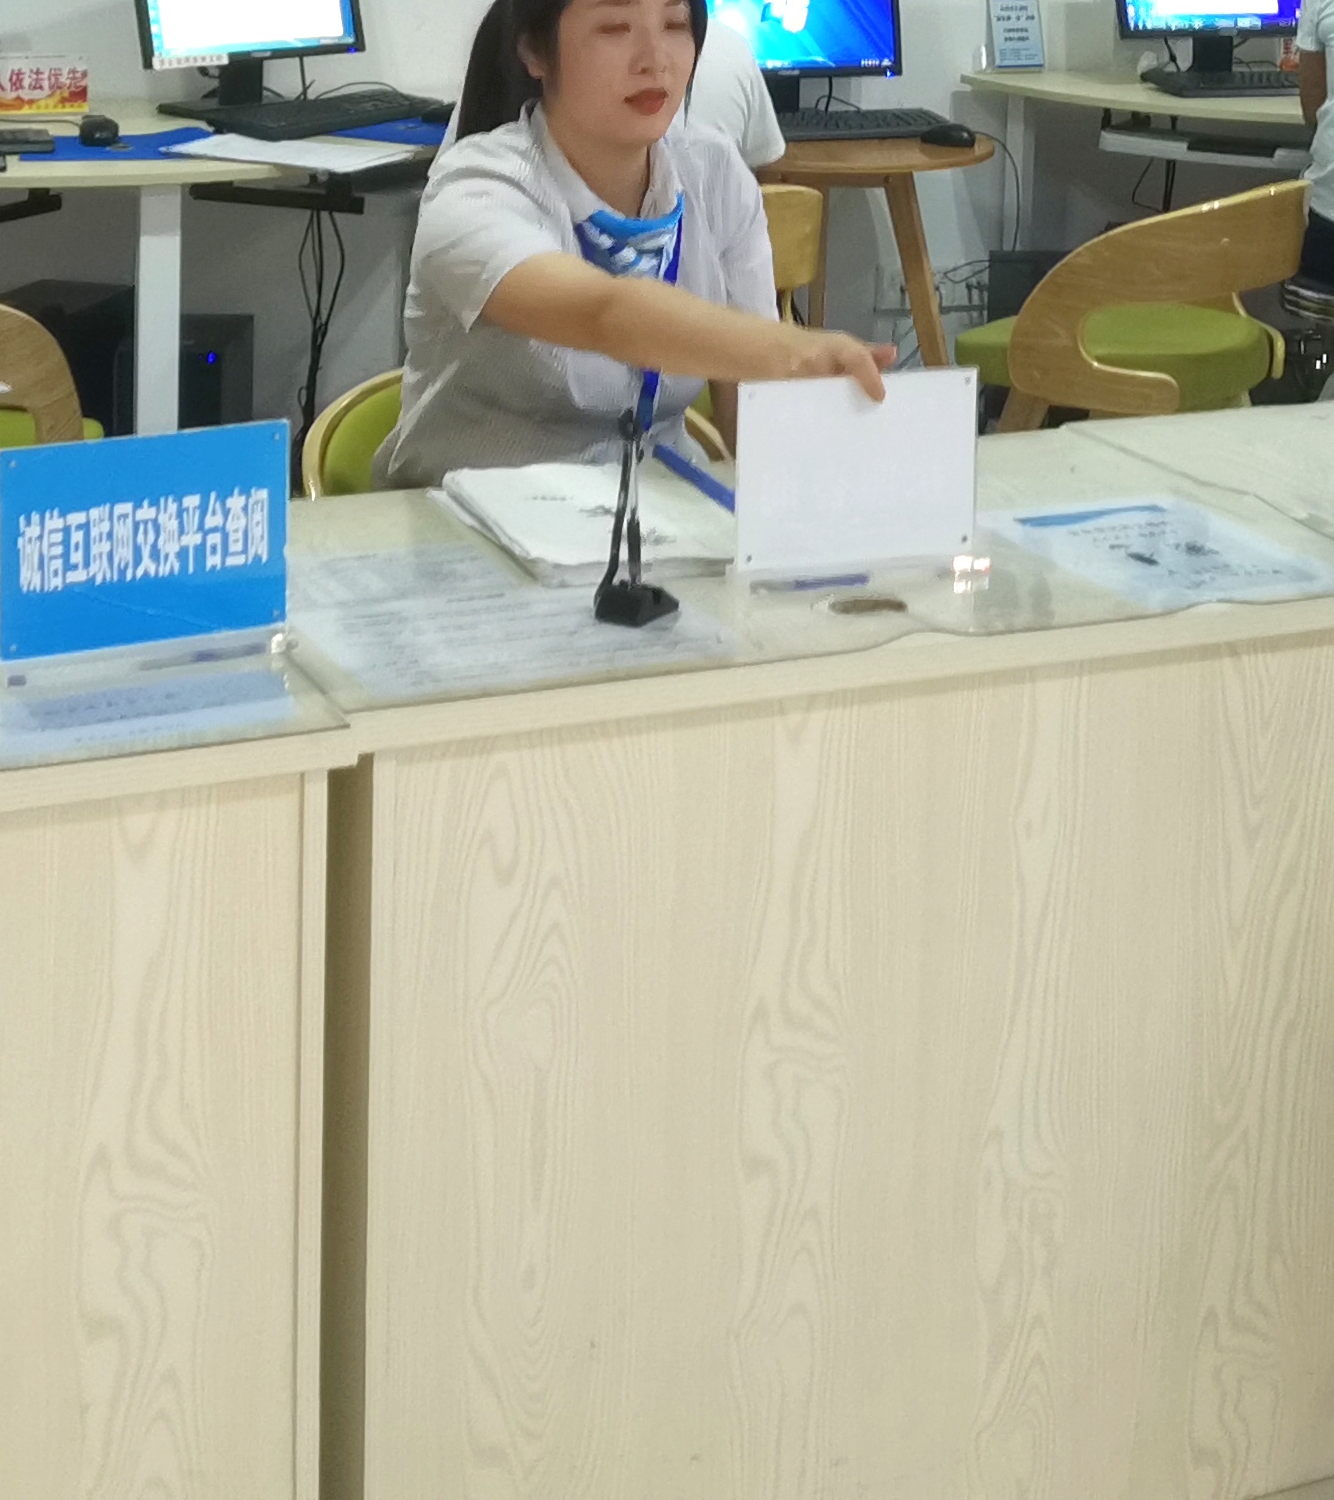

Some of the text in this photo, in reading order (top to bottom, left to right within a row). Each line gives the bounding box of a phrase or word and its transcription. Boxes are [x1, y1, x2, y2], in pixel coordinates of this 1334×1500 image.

[17, 486, 268, 593] 诚信互联网交换平台查阅
